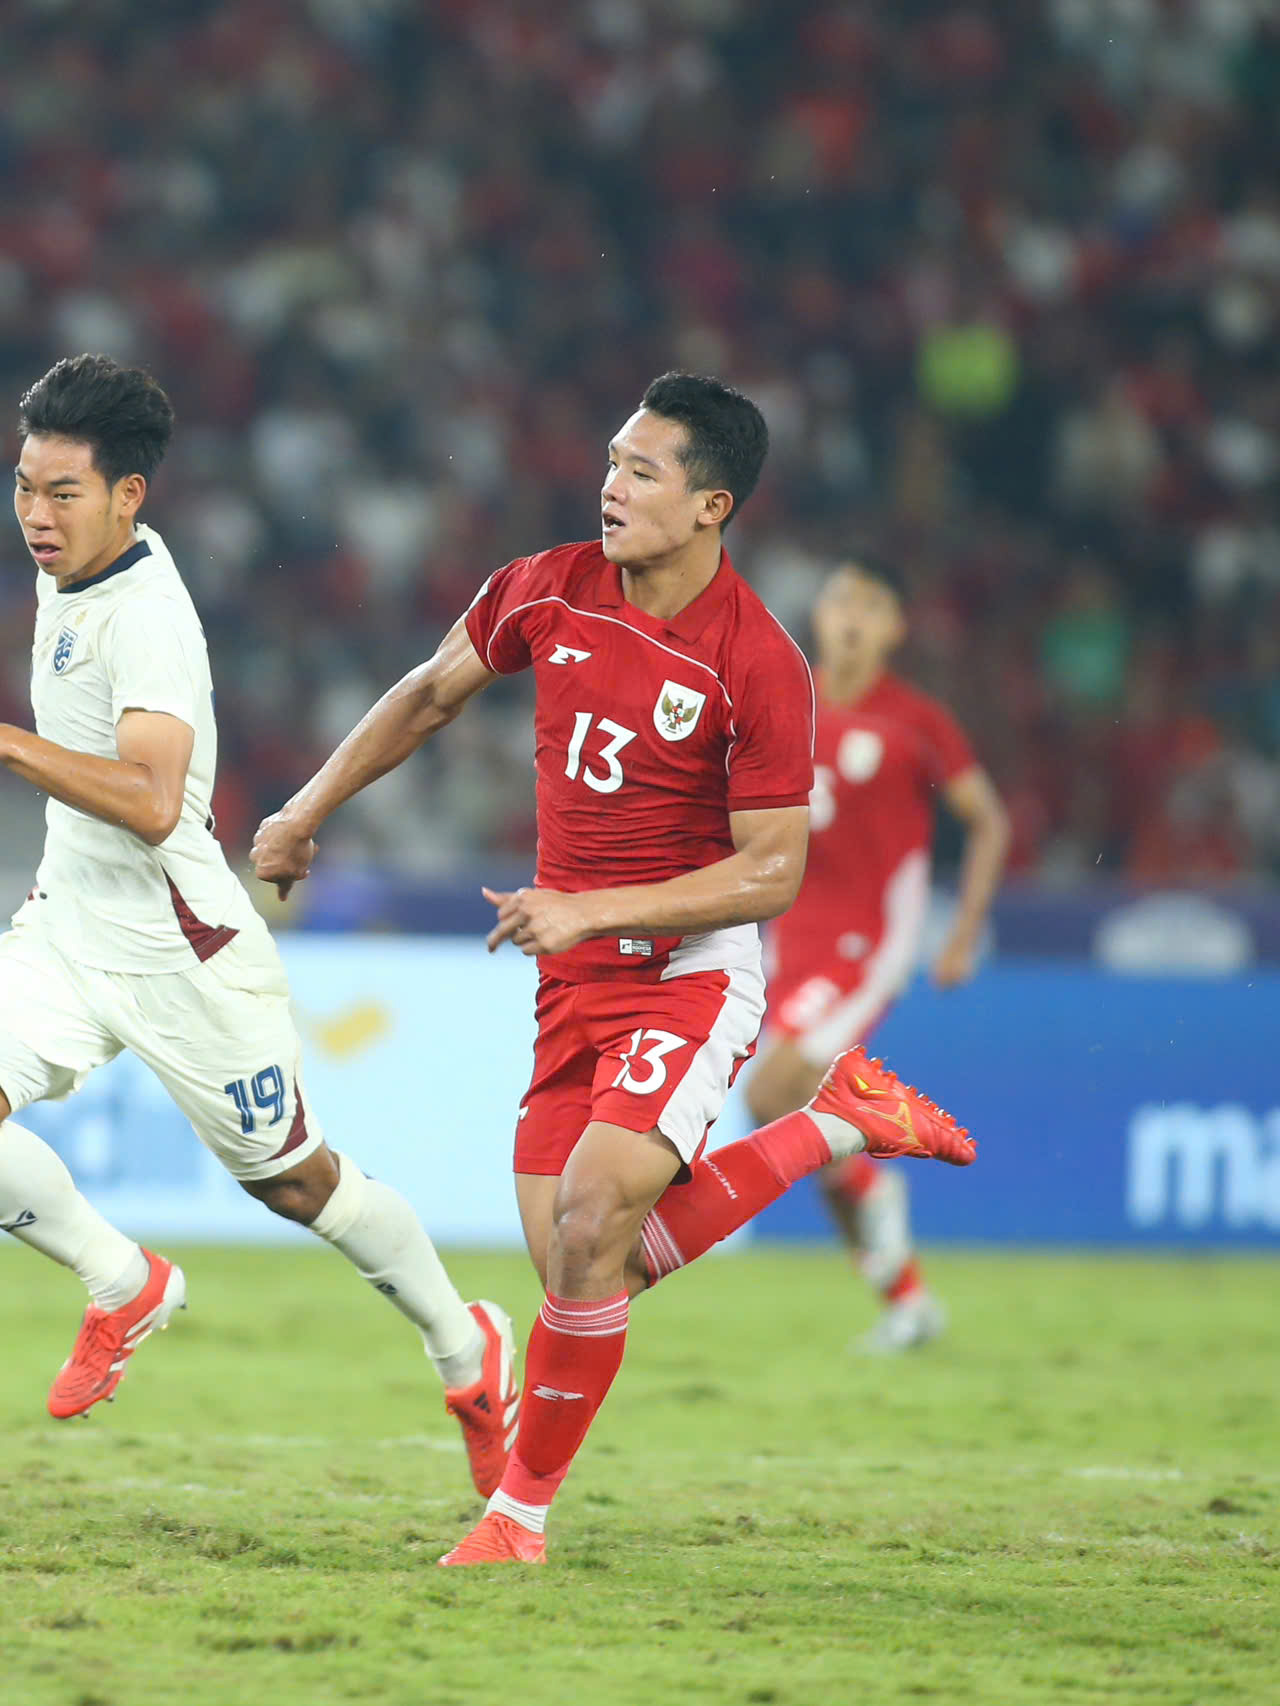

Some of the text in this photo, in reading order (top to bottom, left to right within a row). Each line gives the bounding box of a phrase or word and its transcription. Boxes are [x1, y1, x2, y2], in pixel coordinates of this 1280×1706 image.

[564, 711, 638, 794] 13
[611, 1027, 689, 1095] 13
[223, 1064, 285, 1134] 19
